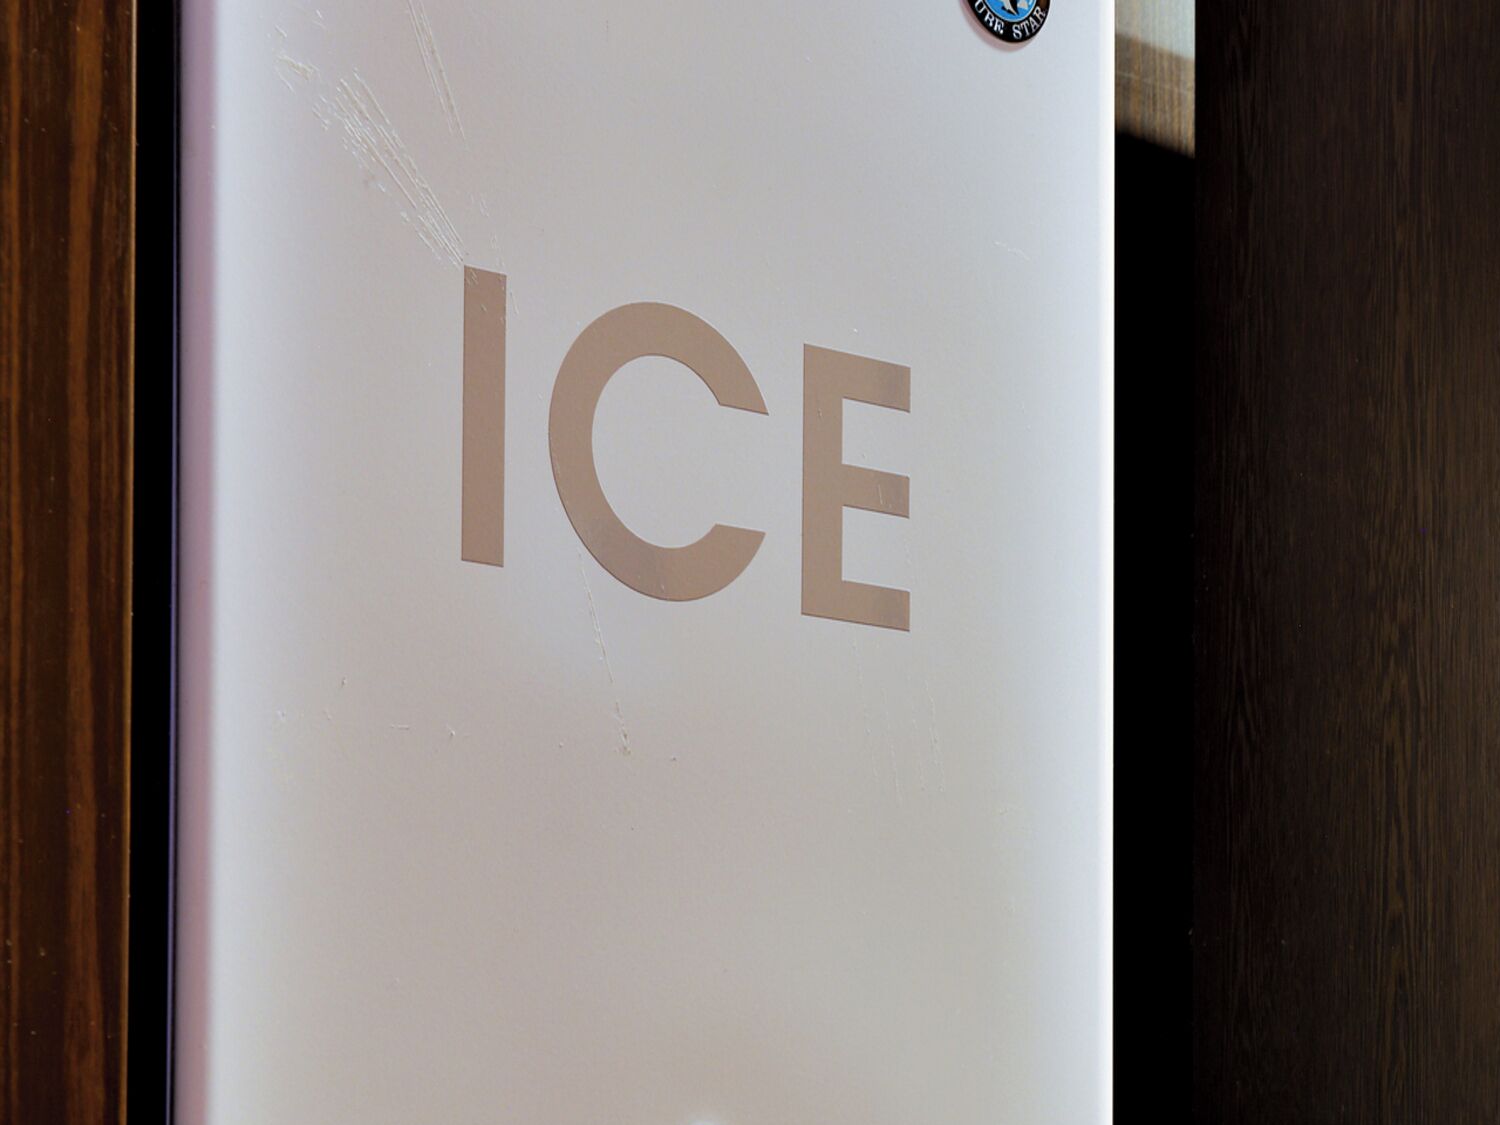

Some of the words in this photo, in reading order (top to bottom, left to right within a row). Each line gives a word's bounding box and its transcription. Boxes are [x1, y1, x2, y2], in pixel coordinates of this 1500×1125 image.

[974, 0, 1004, 35] URE
[1012, 6, 1046, 39] STAR
[461, 264, 911, 632] ICE
